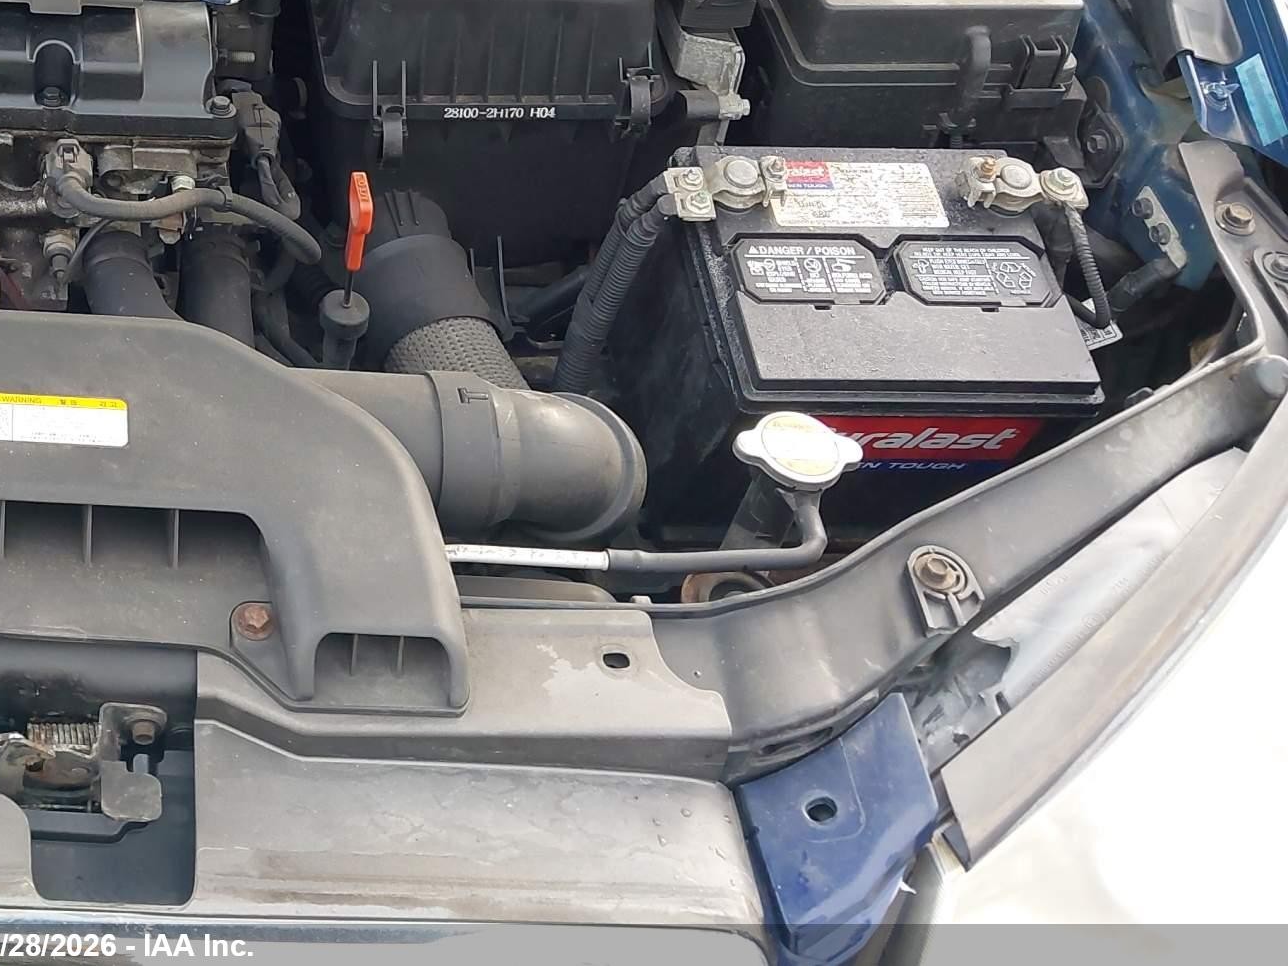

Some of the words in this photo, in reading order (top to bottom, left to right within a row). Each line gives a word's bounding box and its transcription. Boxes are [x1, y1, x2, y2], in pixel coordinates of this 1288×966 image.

[443, 106, 524, 119] 28100-2H170
[529, 106, 557, 119] H04
[786, 165, 825, 178] ralast
[758, 246, 805, 255] DANGER
[814, 247, 856, 256] POISON
[0, 395, 43, 405] WARNING
[852, 427, 1019, 450] ralast
[888, 462, 966, 470] TOUGH
